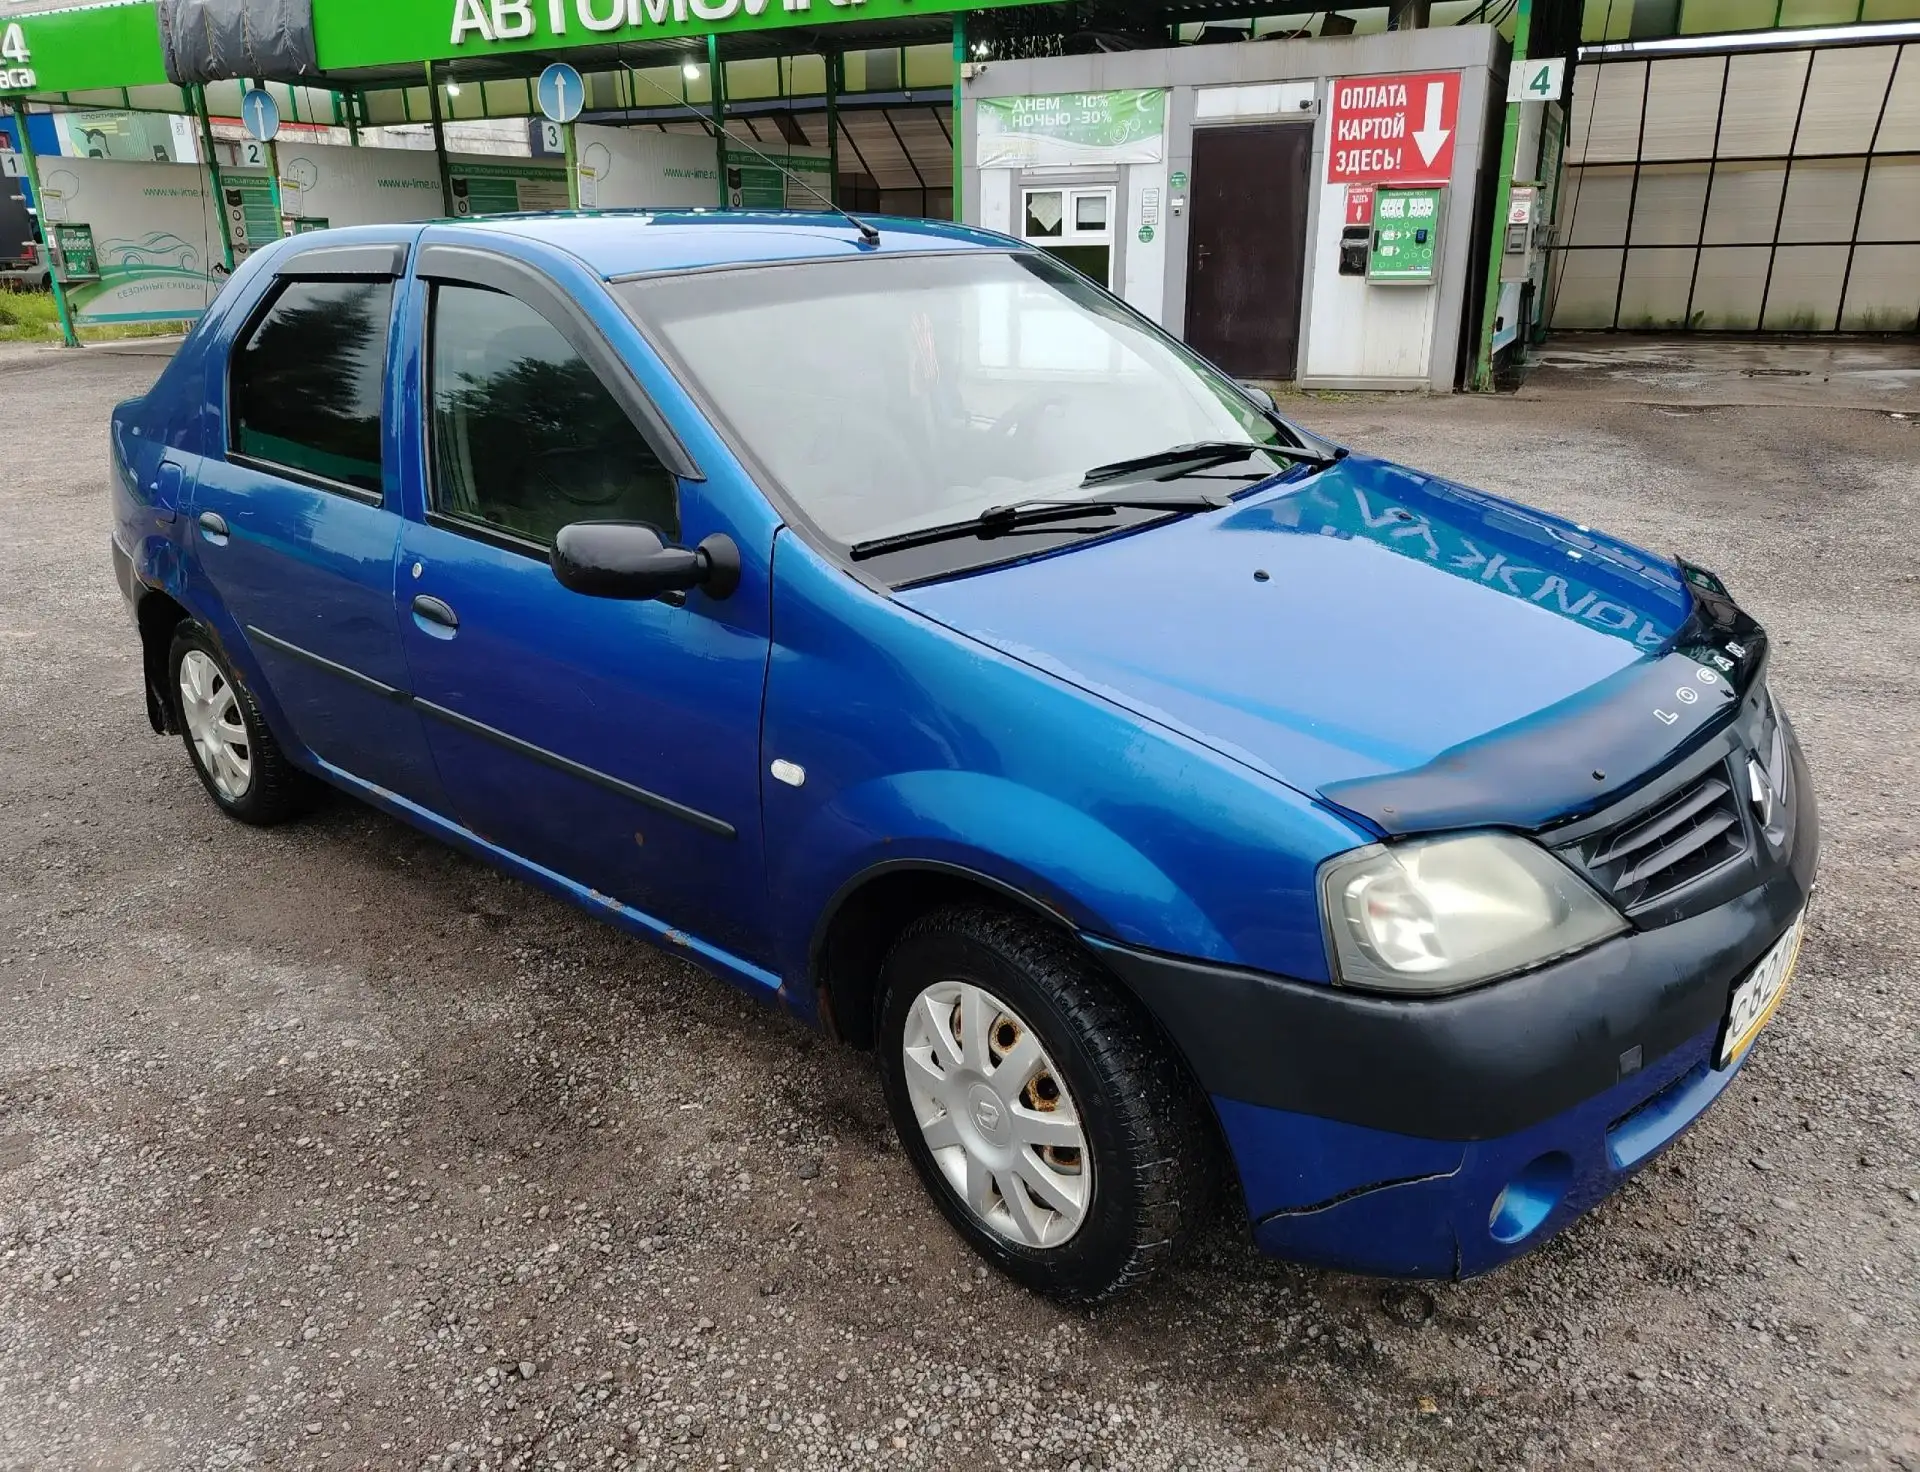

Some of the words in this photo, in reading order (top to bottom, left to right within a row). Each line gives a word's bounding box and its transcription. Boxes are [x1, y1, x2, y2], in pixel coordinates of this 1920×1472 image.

[1529, 65, 1551, 95] 4
[1012, 97, 1060, 114] ДНЕМ
[1075, 95, 1109, 109] -10%
[1340, 84, 1407, 109] ОПЛАТА
[1012, 111, 1071, 127] НОЧЬЮ
[1075, 111, 1112, 124] -30%
[1338, 112, 1405, 141] КАРТОЙ
[547, 126, 558, 147] 3
[248, 145, 260, 163] 2
[1335, 147, 1402, 175] ЗДЕСЬ!
[8, 156, 17, 174] 1
[143, 187, 209, 198] www.w-lime.u
[377, 178, 440, 190] www.w-lime.ru
[117, 281, 165, 300] СЕЗОННЫЕ
[1653, 641, 1746, 725] LOGAN
